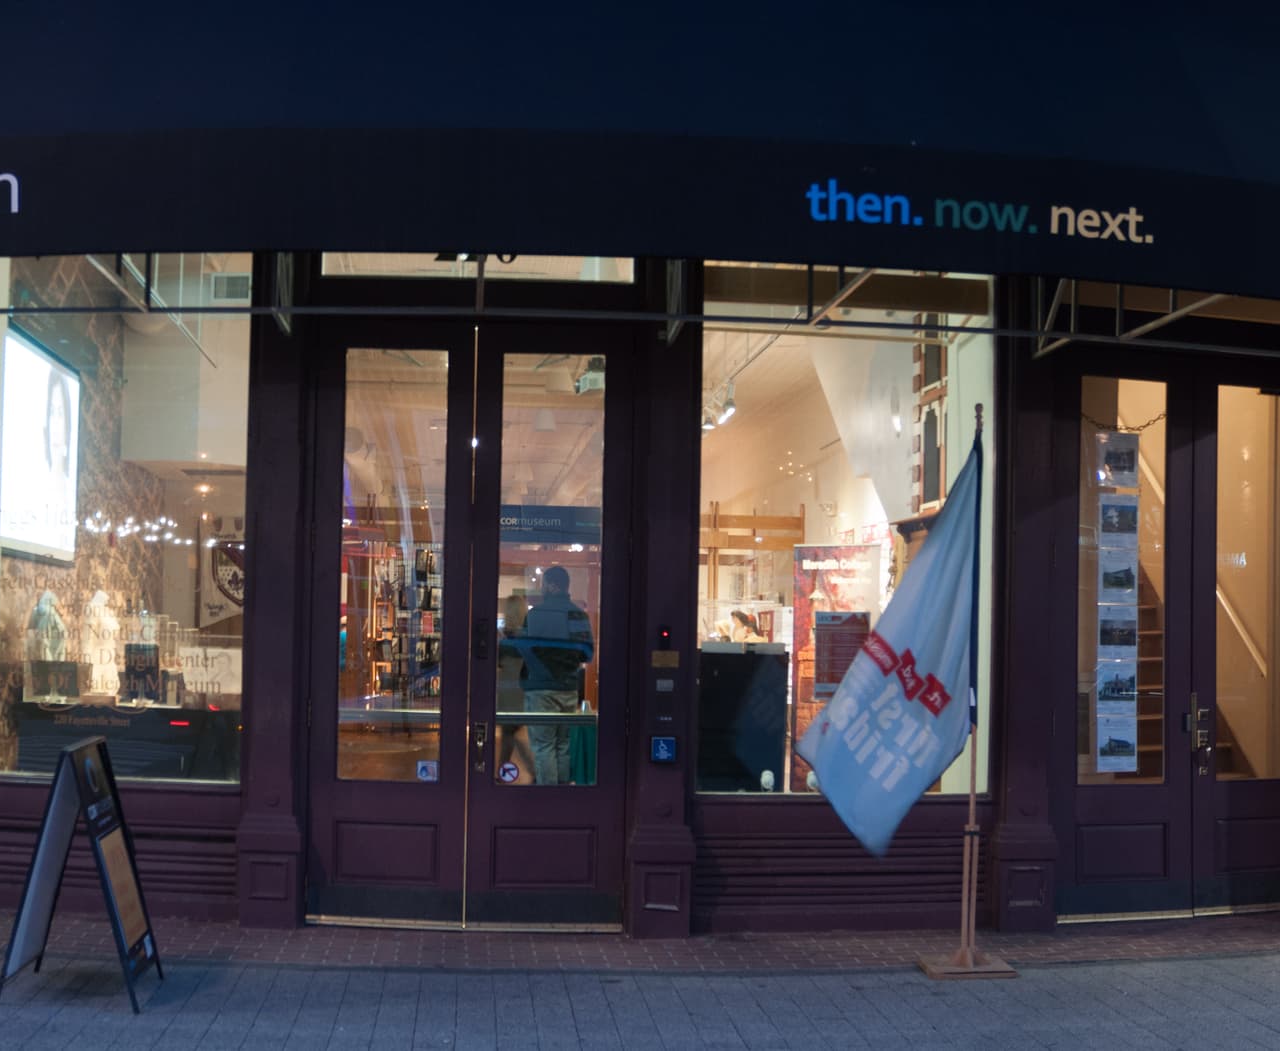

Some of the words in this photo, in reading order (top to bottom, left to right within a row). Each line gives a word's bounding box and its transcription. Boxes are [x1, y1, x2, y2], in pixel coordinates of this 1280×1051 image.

[806, 178, 923, 226] then.
[935, 198, 1038, 233] now.
[1050, 205, 1154, 243] next.
